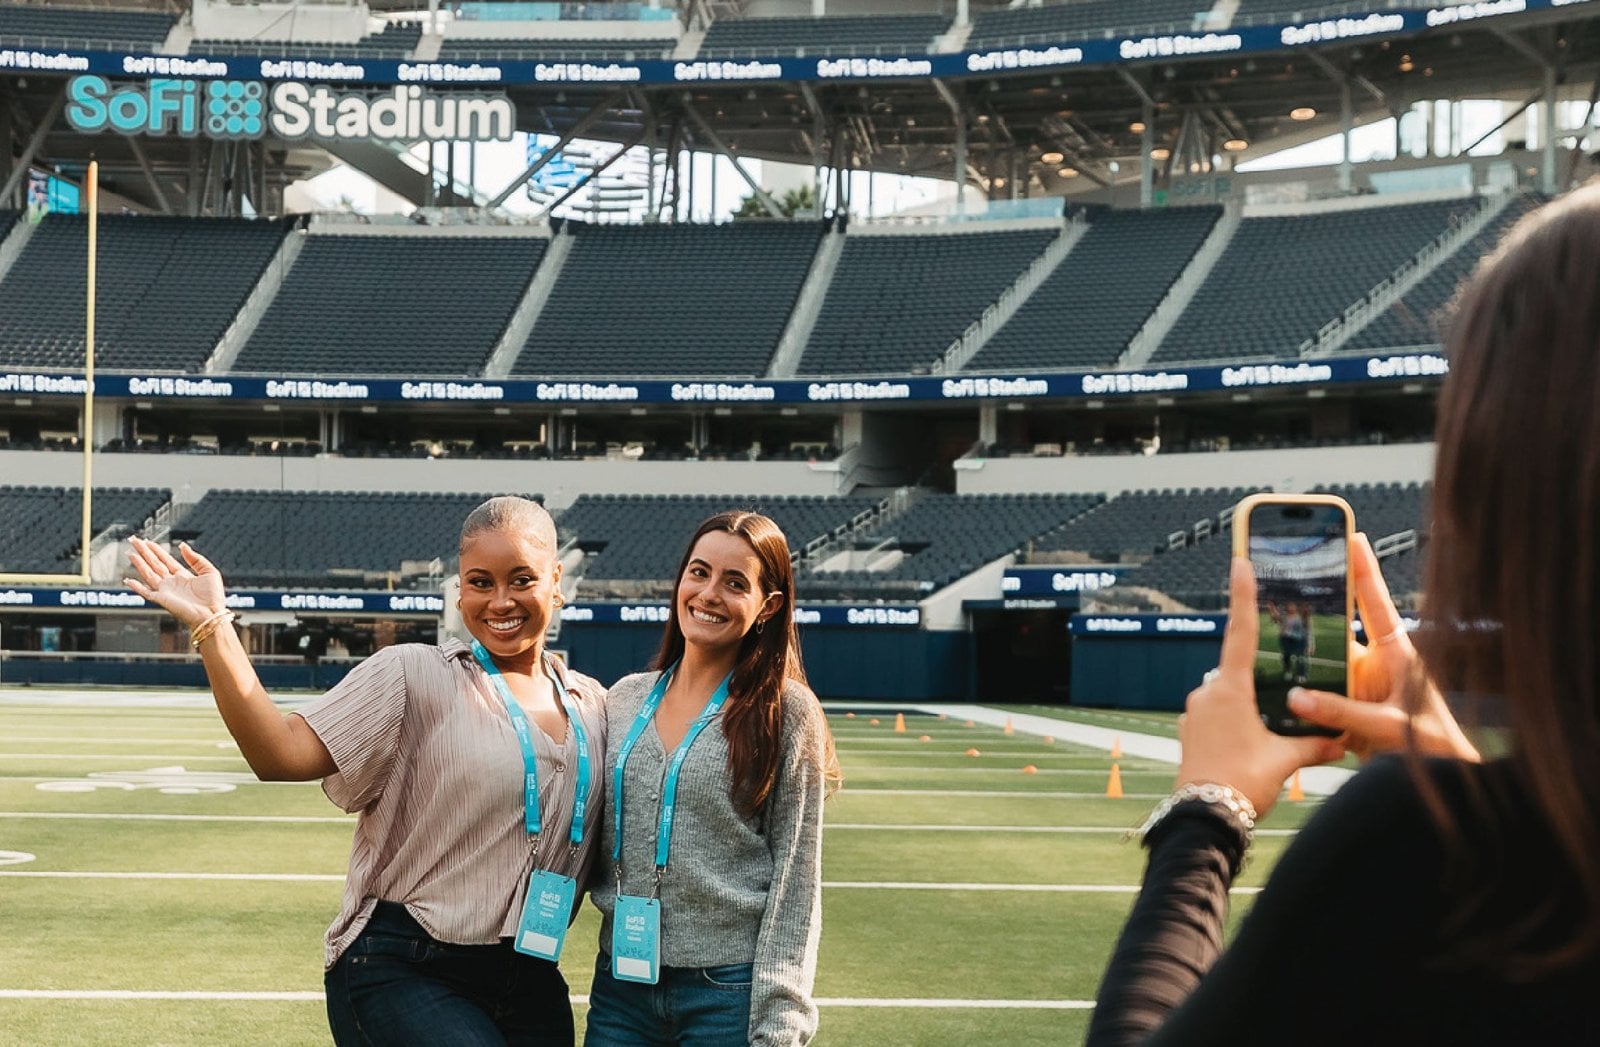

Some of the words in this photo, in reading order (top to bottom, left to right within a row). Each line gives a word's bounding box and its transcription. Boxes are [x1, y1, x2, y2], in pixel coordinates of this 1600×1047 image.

[0, 50, 14, 67] Fi
[70, 75, 195, 132] SoFi
[273, 81, 512, 138] Stadium
[0, 374, 19, 391] oFi
[888, 609, 919, 624] Stadi
